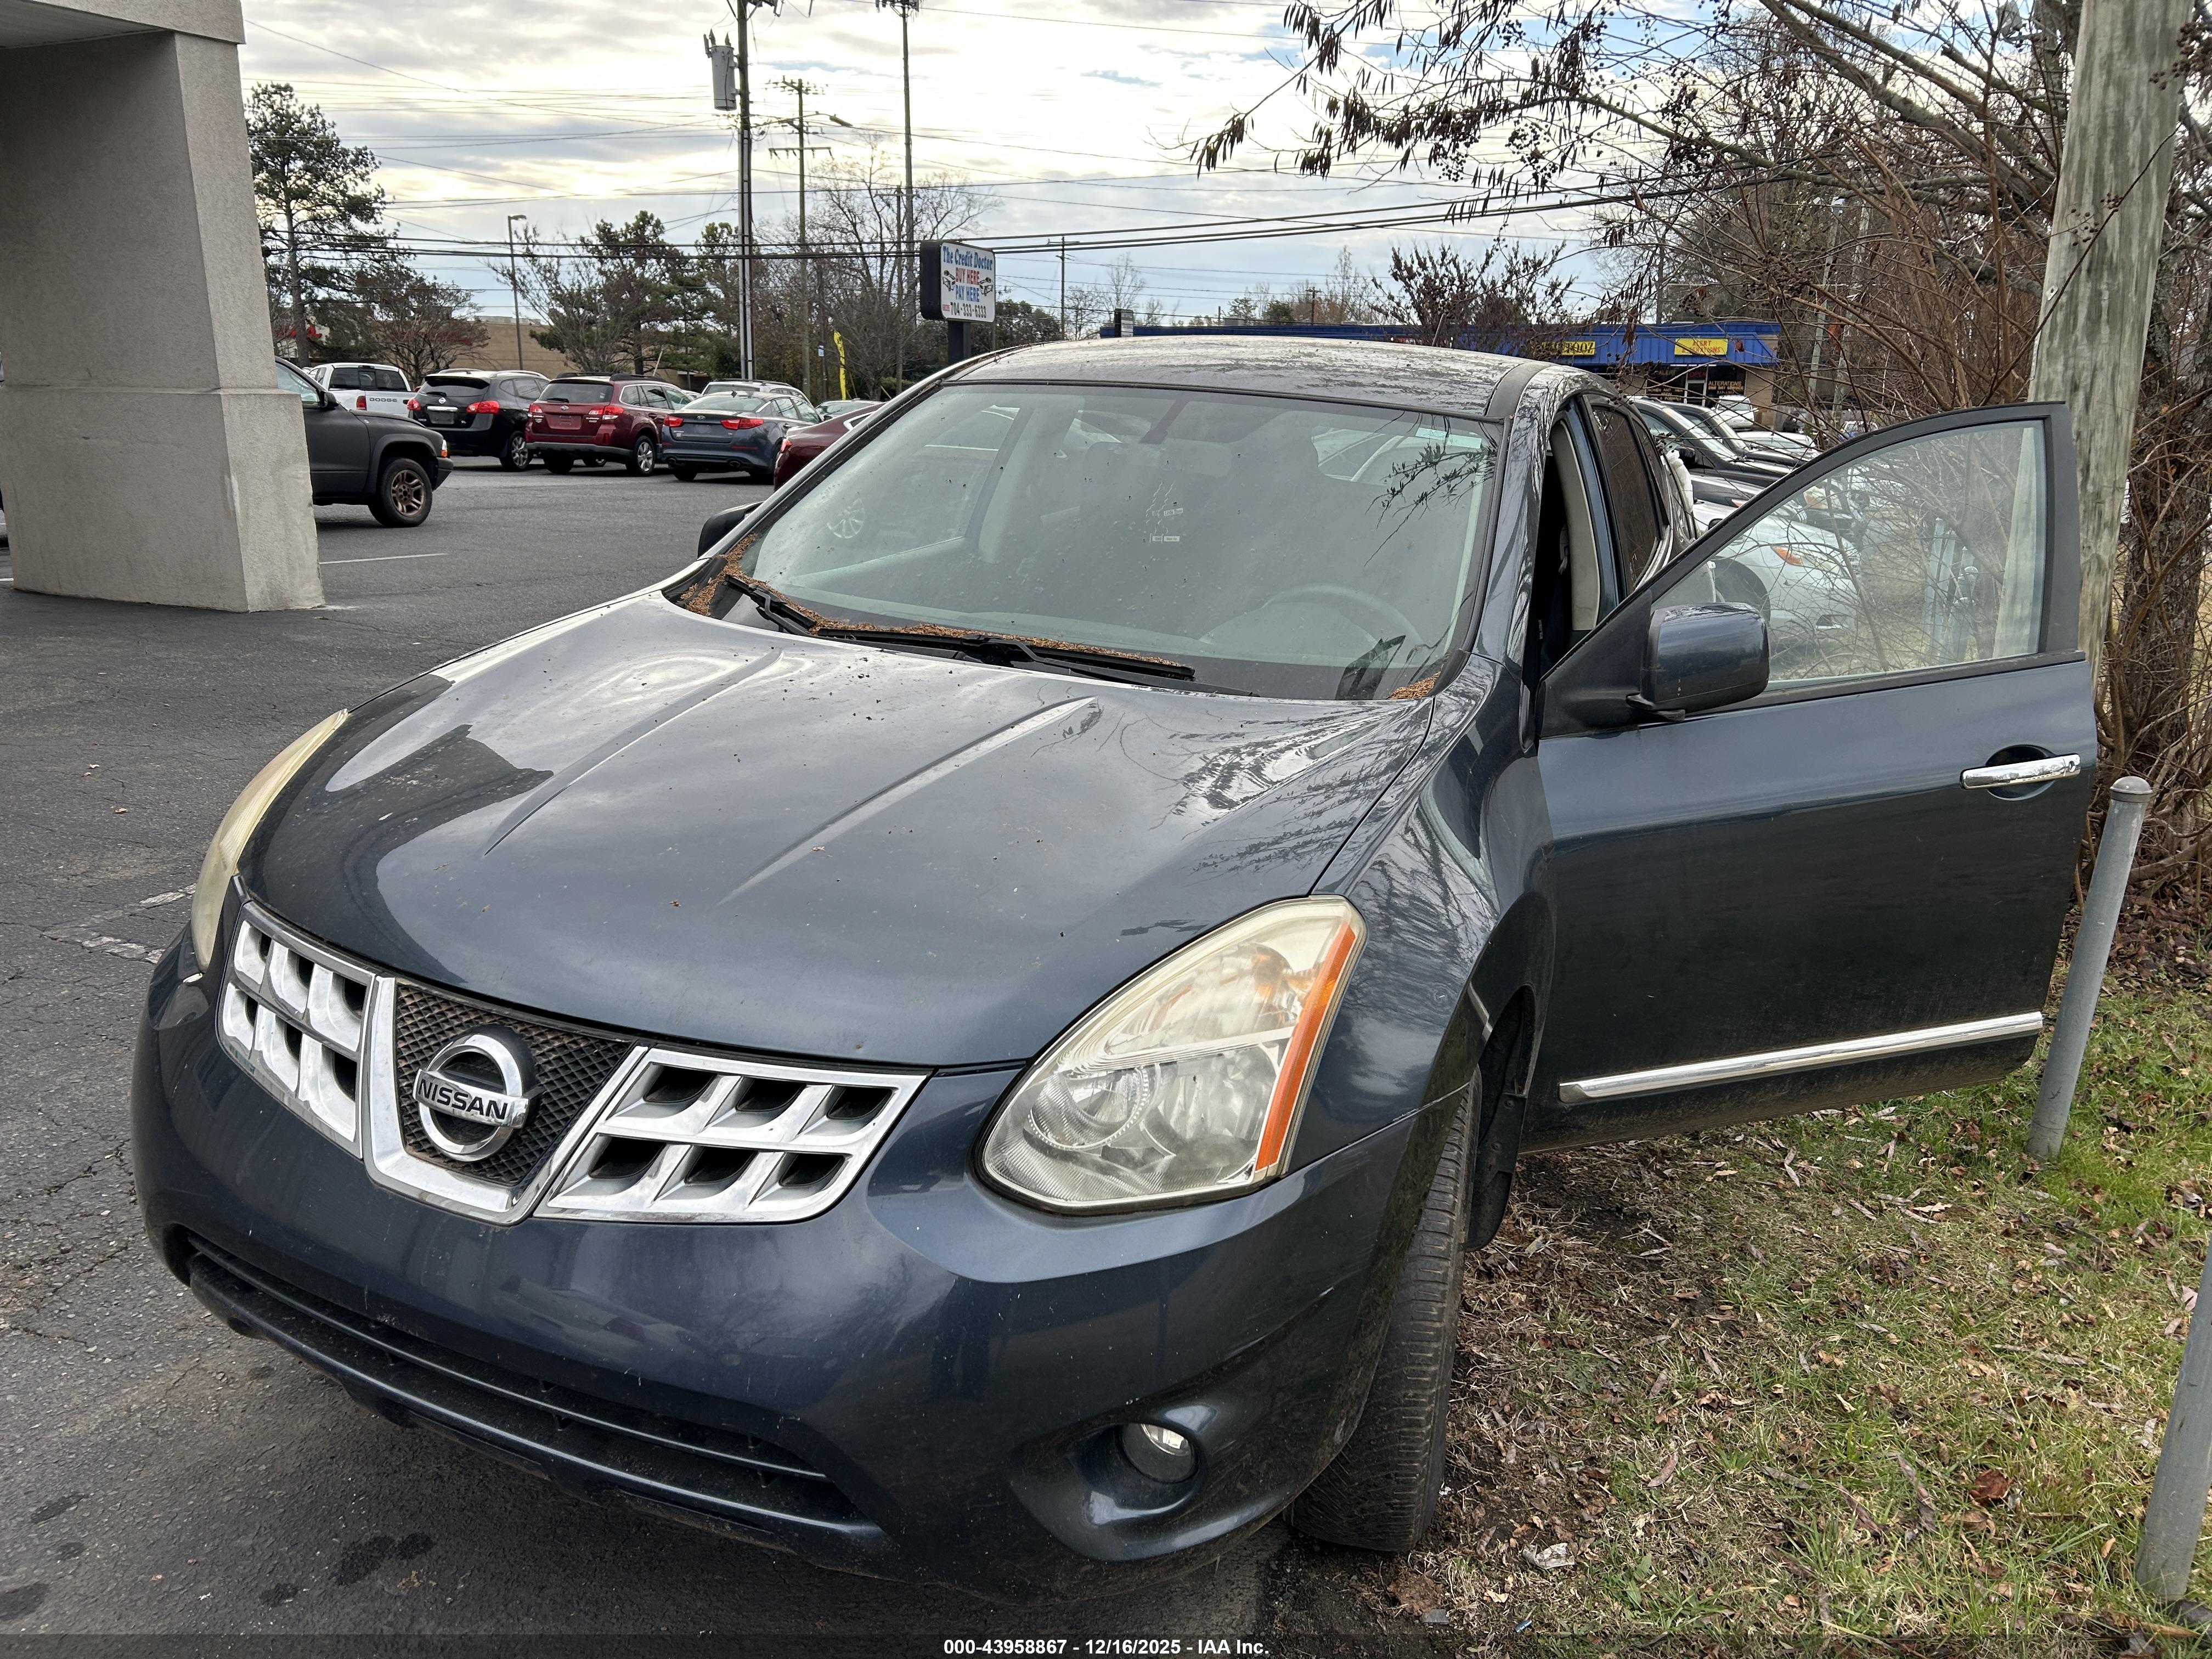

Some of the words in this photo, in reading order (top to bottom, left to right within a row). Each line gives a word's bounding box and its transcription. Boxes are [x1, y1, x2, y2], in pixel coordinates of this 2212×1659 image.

[943, 246, 953, 264] The
[955, 248, 973, 267] Credit
[974, 252, 992, 270] Doctor
[956, 267, 966, 283] BUY
[967, 269, 980, 285] HERE
[956, 285, 964, 300] PAY
[966, 286, 979, 302] HERE
[418, 1079, 508, 1120] NISSAN
